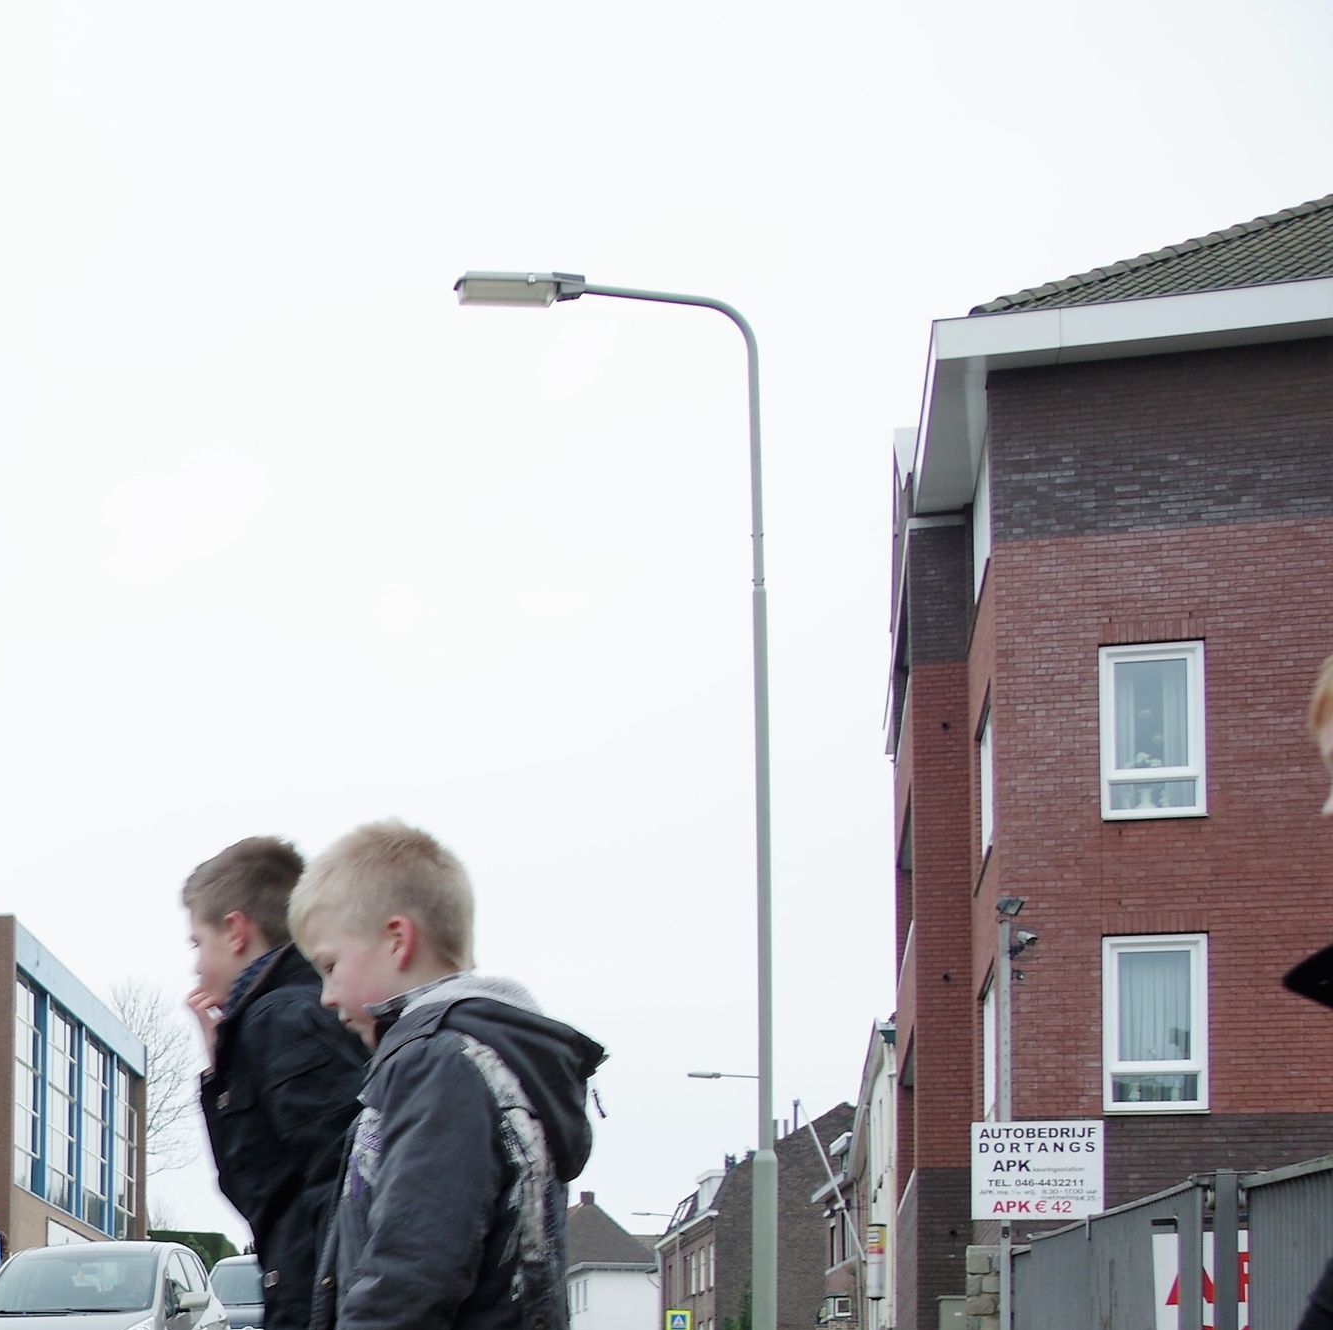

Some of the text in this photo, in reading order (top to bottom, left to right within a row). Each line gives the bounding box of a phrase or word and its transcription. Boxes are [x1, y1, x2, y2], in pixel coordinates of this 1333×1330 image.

[979, 1127, 1096, 1139] AUTOBEDRIJF
[979, 1142, 1095, 1153] DORTANGS
[993, 1159, 1031, 1172] APK
[988, 1179, 1084, 1187] TEL. 046-4432211
[993, 1200, 1072, 1214] APK € 42
